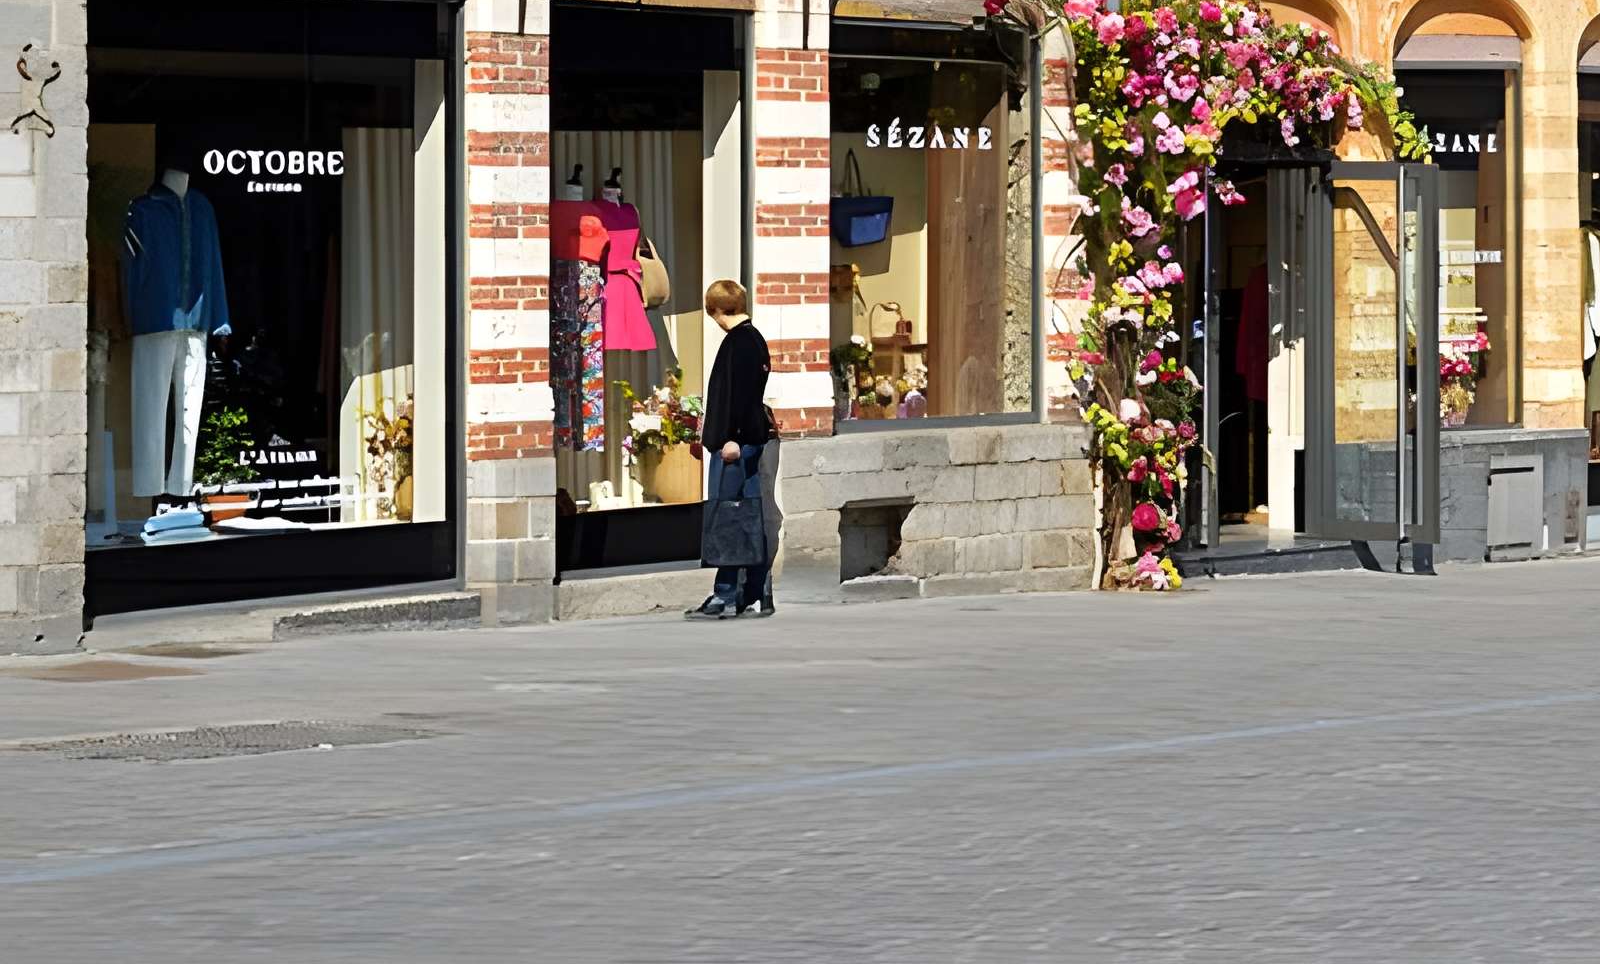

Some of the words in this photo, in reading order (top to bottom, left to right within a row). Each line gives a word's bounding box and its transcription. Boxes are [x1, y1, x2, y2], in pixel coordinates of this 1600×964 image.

[866, 117, 993, 150] SÉZANE
[1434, 133, 1497, 152] ZANE
[203, 149, 344, 175] OCTOBRE
